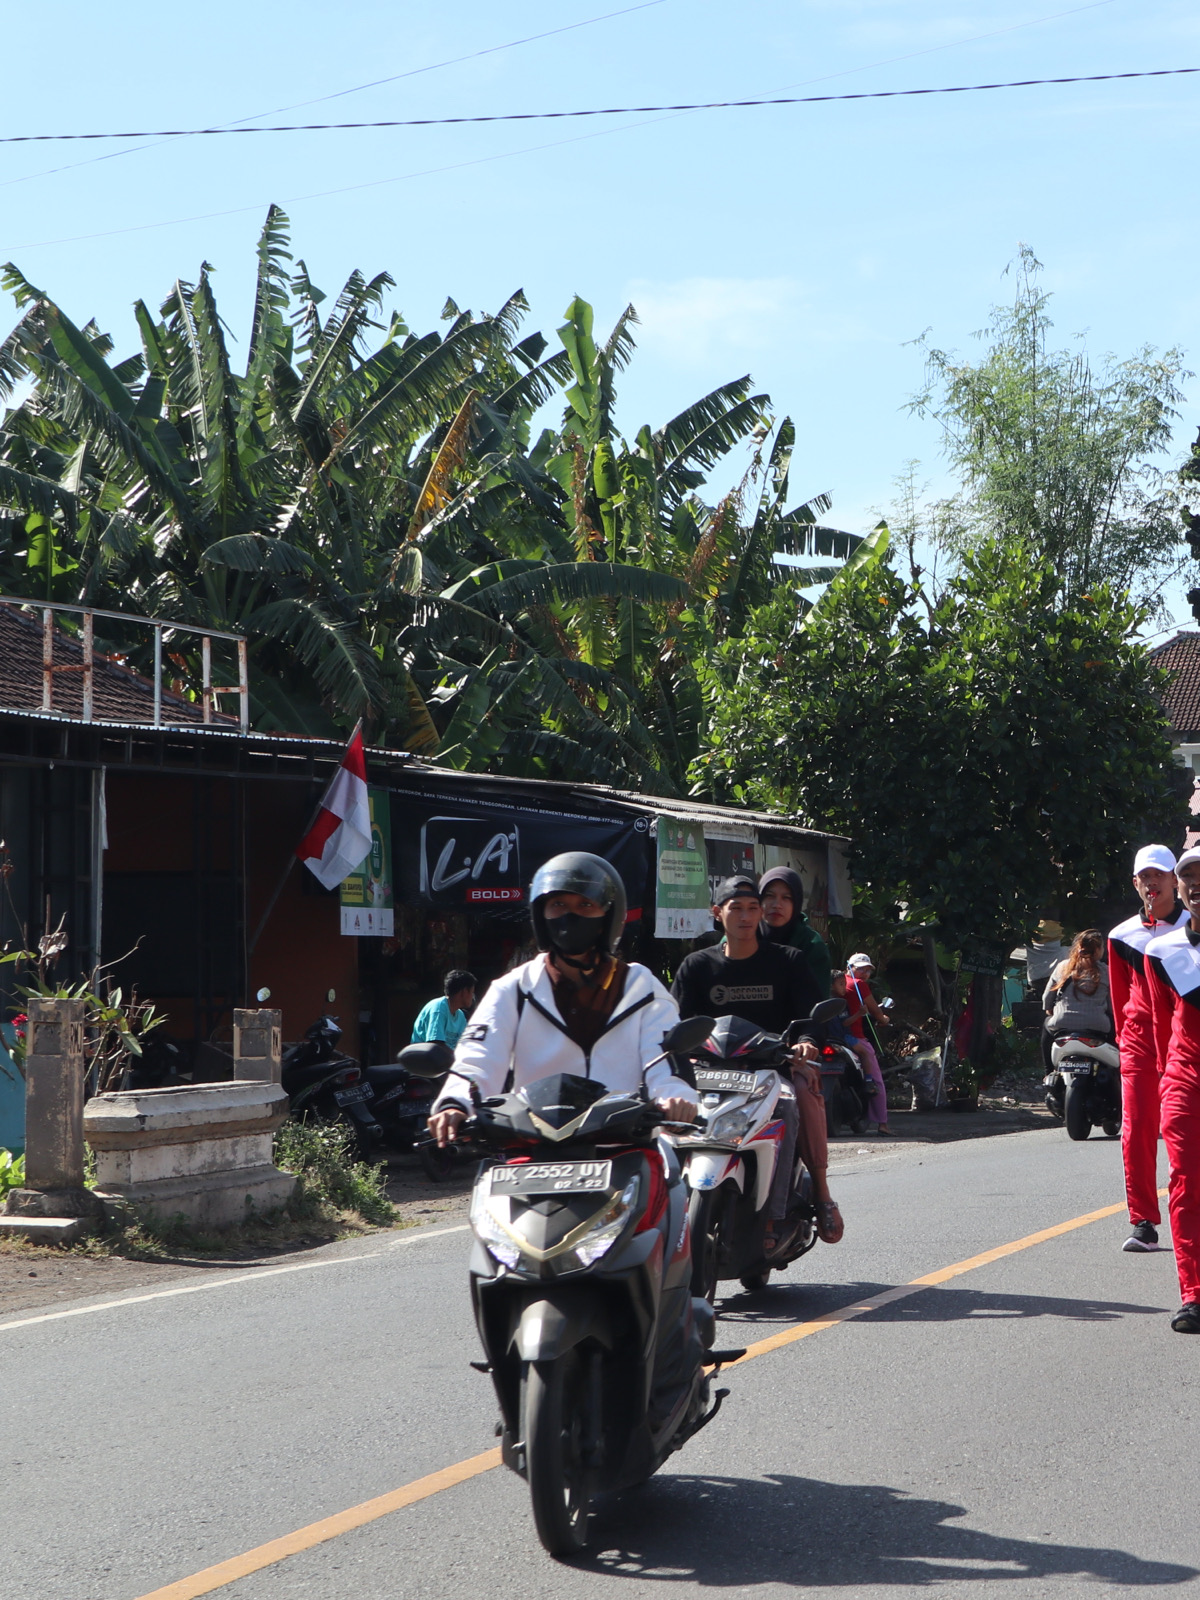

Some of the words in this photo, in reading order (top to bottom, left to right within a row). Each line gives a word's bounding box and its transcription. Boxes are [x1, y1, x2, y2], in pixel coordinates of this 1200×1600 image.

[517, 805, 538, 813] LAYANAN
[471, 890, 511, 899] BOLD
[699, 1071, 729, 1080] 3860
[732, 1073, 754, 1083] UAL
[493, 1168, 519, 1182] DK
[524, 1164, 575, 1180] 2552
[579, 1163, 608, 1177] UY
